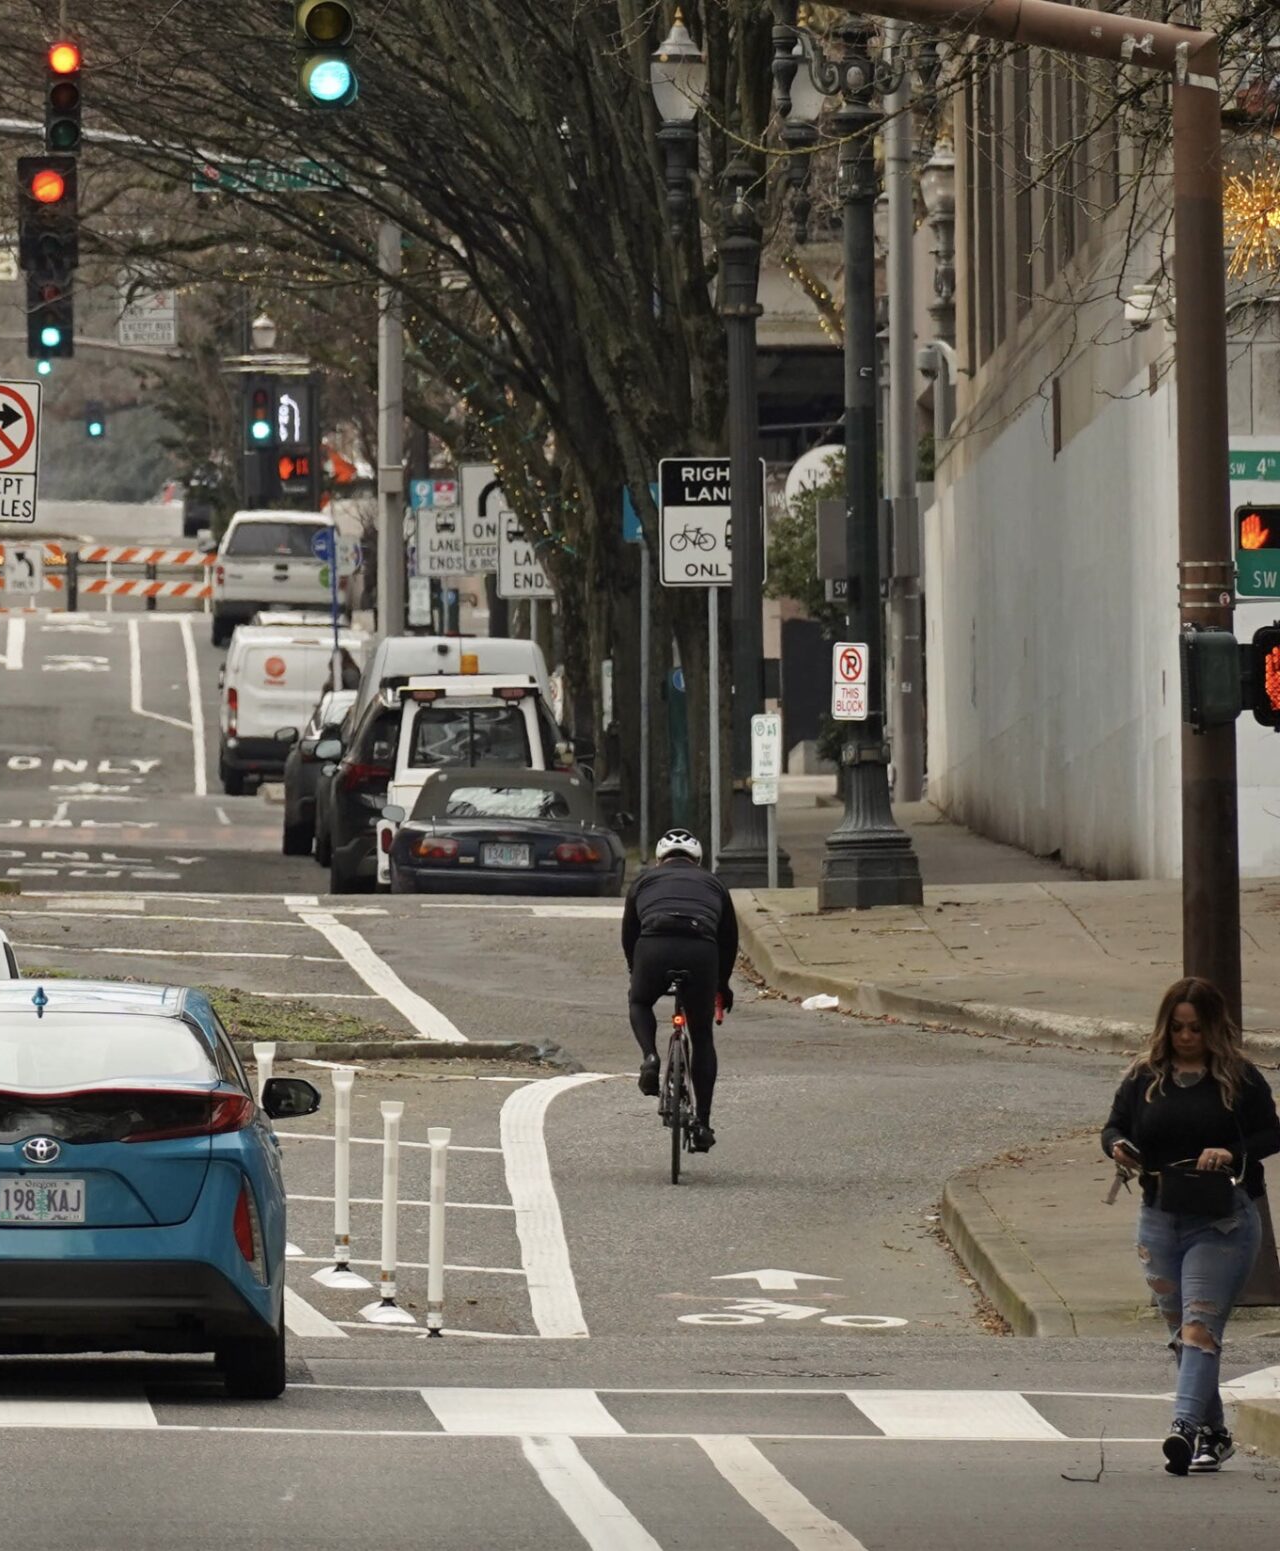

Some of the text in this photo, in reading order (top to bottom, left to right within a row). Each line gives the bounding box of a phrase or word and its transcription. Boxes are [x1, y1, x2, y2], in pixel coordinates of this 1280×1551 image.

[681, 466, 730, 482] RIGH
[1230, 457, 1276, 475] SW 4th
[684, 486, 731, 502] LAN
[473, 523, 497, 539] ON
[430, 540, 461, 552] LANE
[469, 546, 497, 557] EXCEP
[430, 558, 464, 570] ENDS
[514, 550, 539, 566] LA
[1253, 570, 1277, 589] SW
[841, 687, 860, 699] THIS
[835, 700, 863, 712] BLOCK
[7, 756, 162, 774] ONLY
[25, 1180, 57, 1190] Oregon
[4, 1188, 81, 1211] 198 KAJ
